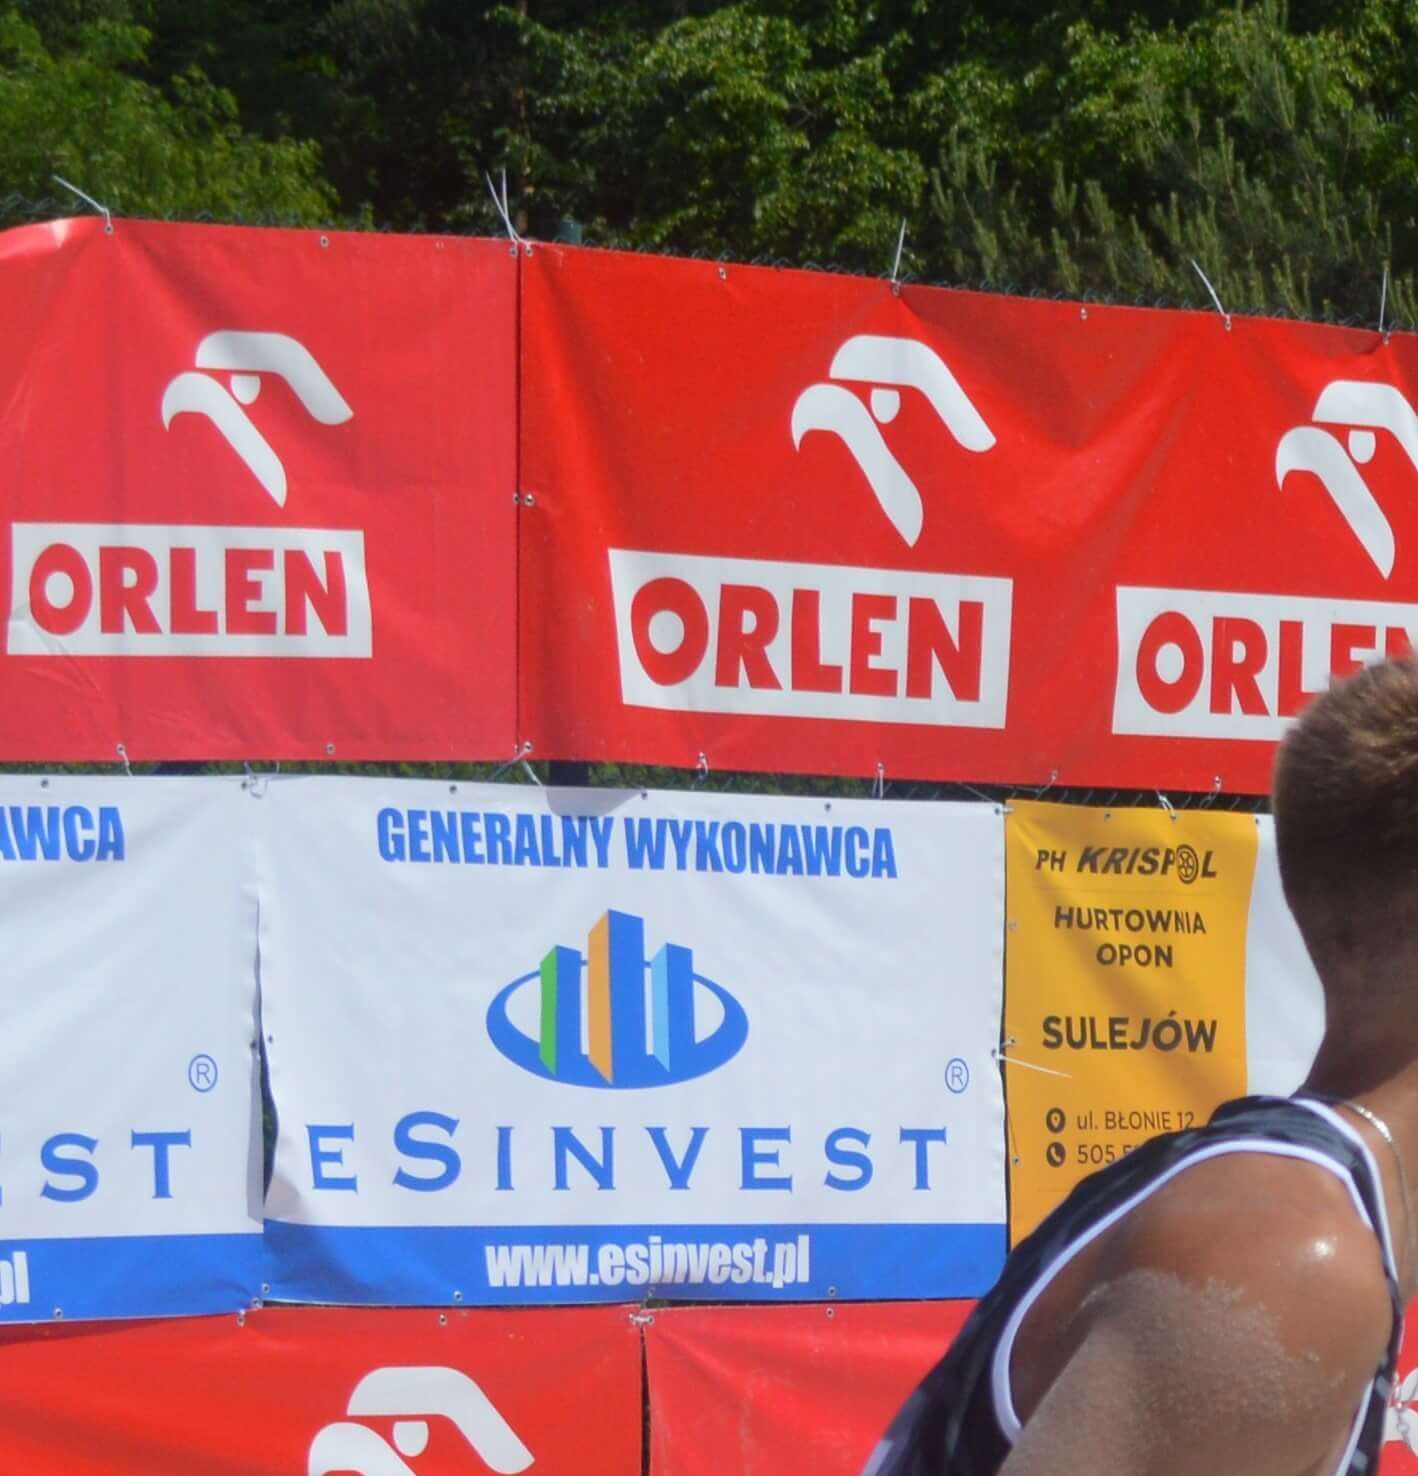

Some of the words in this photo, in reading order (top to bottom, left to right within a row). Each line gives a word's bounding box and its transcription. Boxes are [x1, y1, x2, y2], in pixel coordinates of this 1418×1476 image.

[29, 542, 348, 636] ORLEN
[631, 576, 983, 703] ORLEN
[376, 807, 614, 868] GENERALNY
[625, 817, 898, 879] WYKONAWCA
[1036, 849, 1065, 872] PH
[1077, 845, 1217, 884] KRISPOL
[1054, 905, 1206, 936] HURTOWNIA
[1096, 943, 1174, 969] OPON
[1042, 1010, 1217, 1053] SULEJÓW
[1077, 1111, 1099, 1130] ul.
[1104, 1111, 1171, 1130] BŁONIE
[306, 1111, 947, 1194] ESINVEST
[1077, 1144, 1115, 1164] 505
[485, 1235, 810, 1288] www.esinvest.pl
